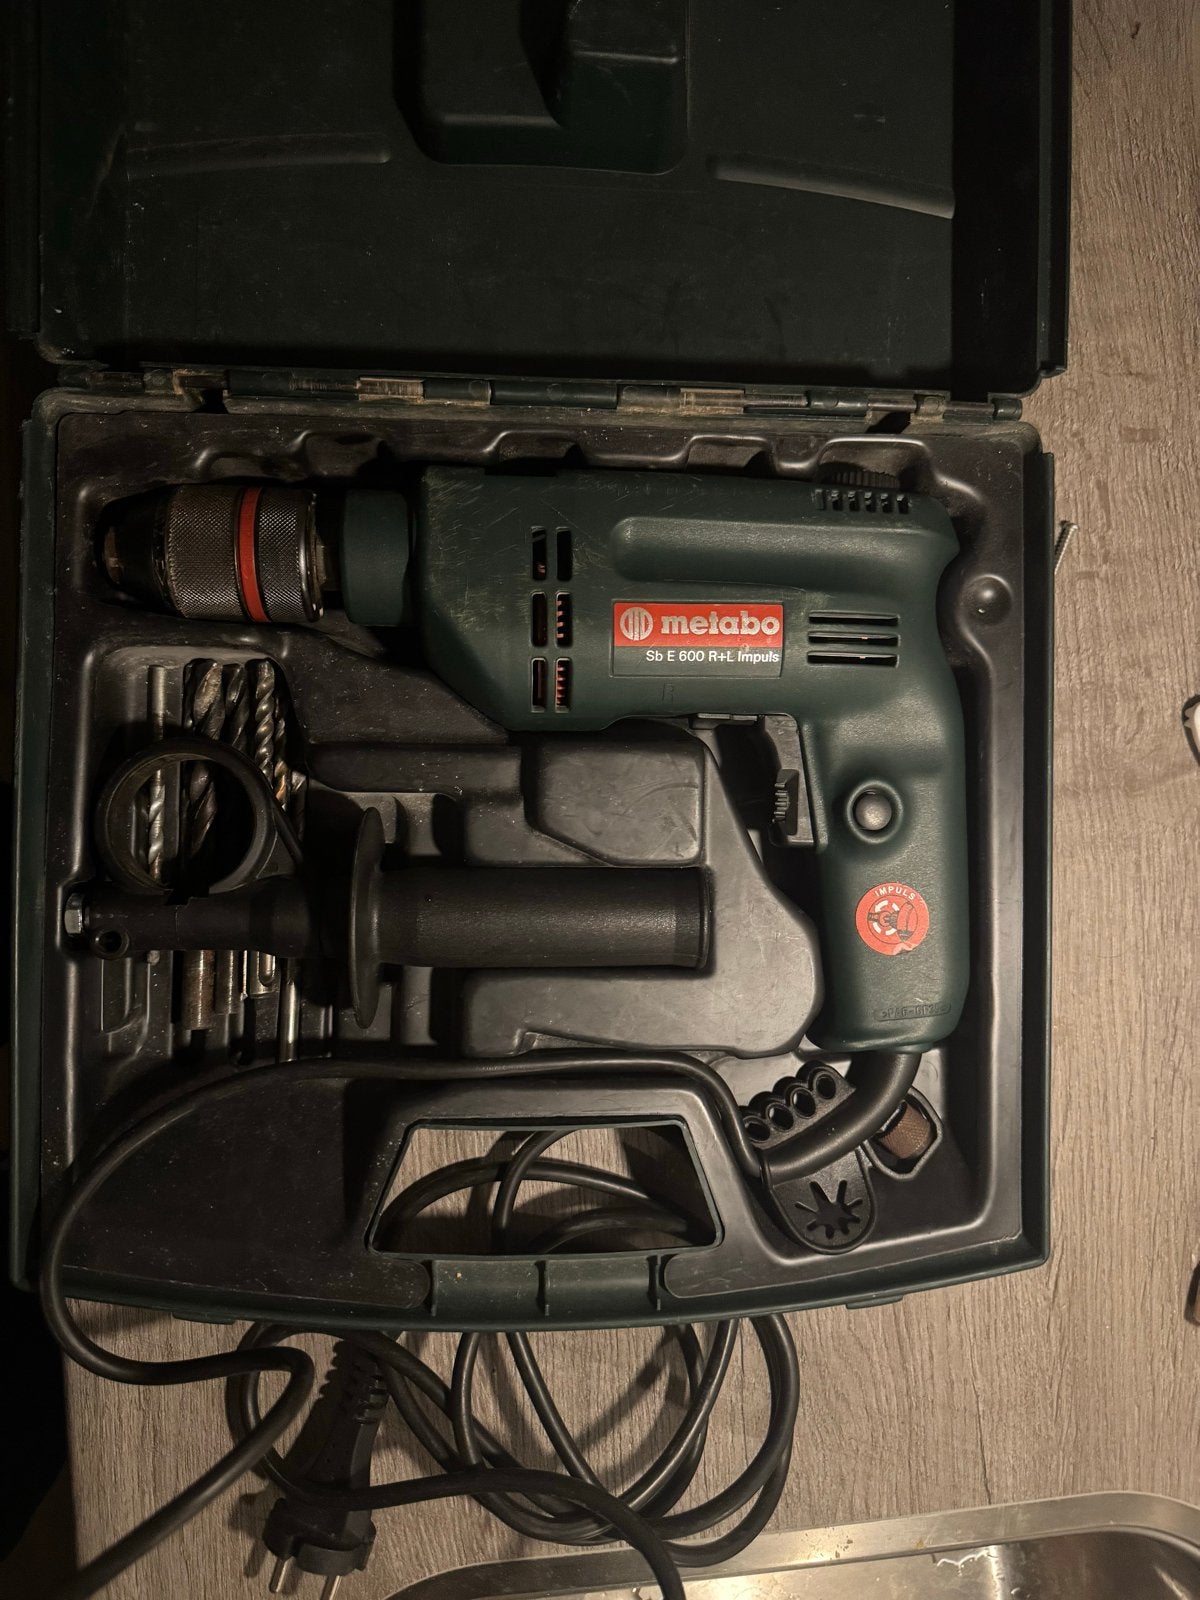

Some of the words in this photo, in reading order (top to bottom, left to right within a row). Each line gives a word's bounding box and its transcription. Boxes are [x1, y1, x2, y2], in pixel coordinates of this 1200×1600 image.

[661, 611, 780, 635] metabo
[646, 650, 663, 662] Sb
[667, 651, 675, 662] E
[679, 651, 705, 662] 600
[708, 651, 735, 662] R+L
[738, 651, 779, 664] Impuls
[875, 886, 916, 900] IMPULS
